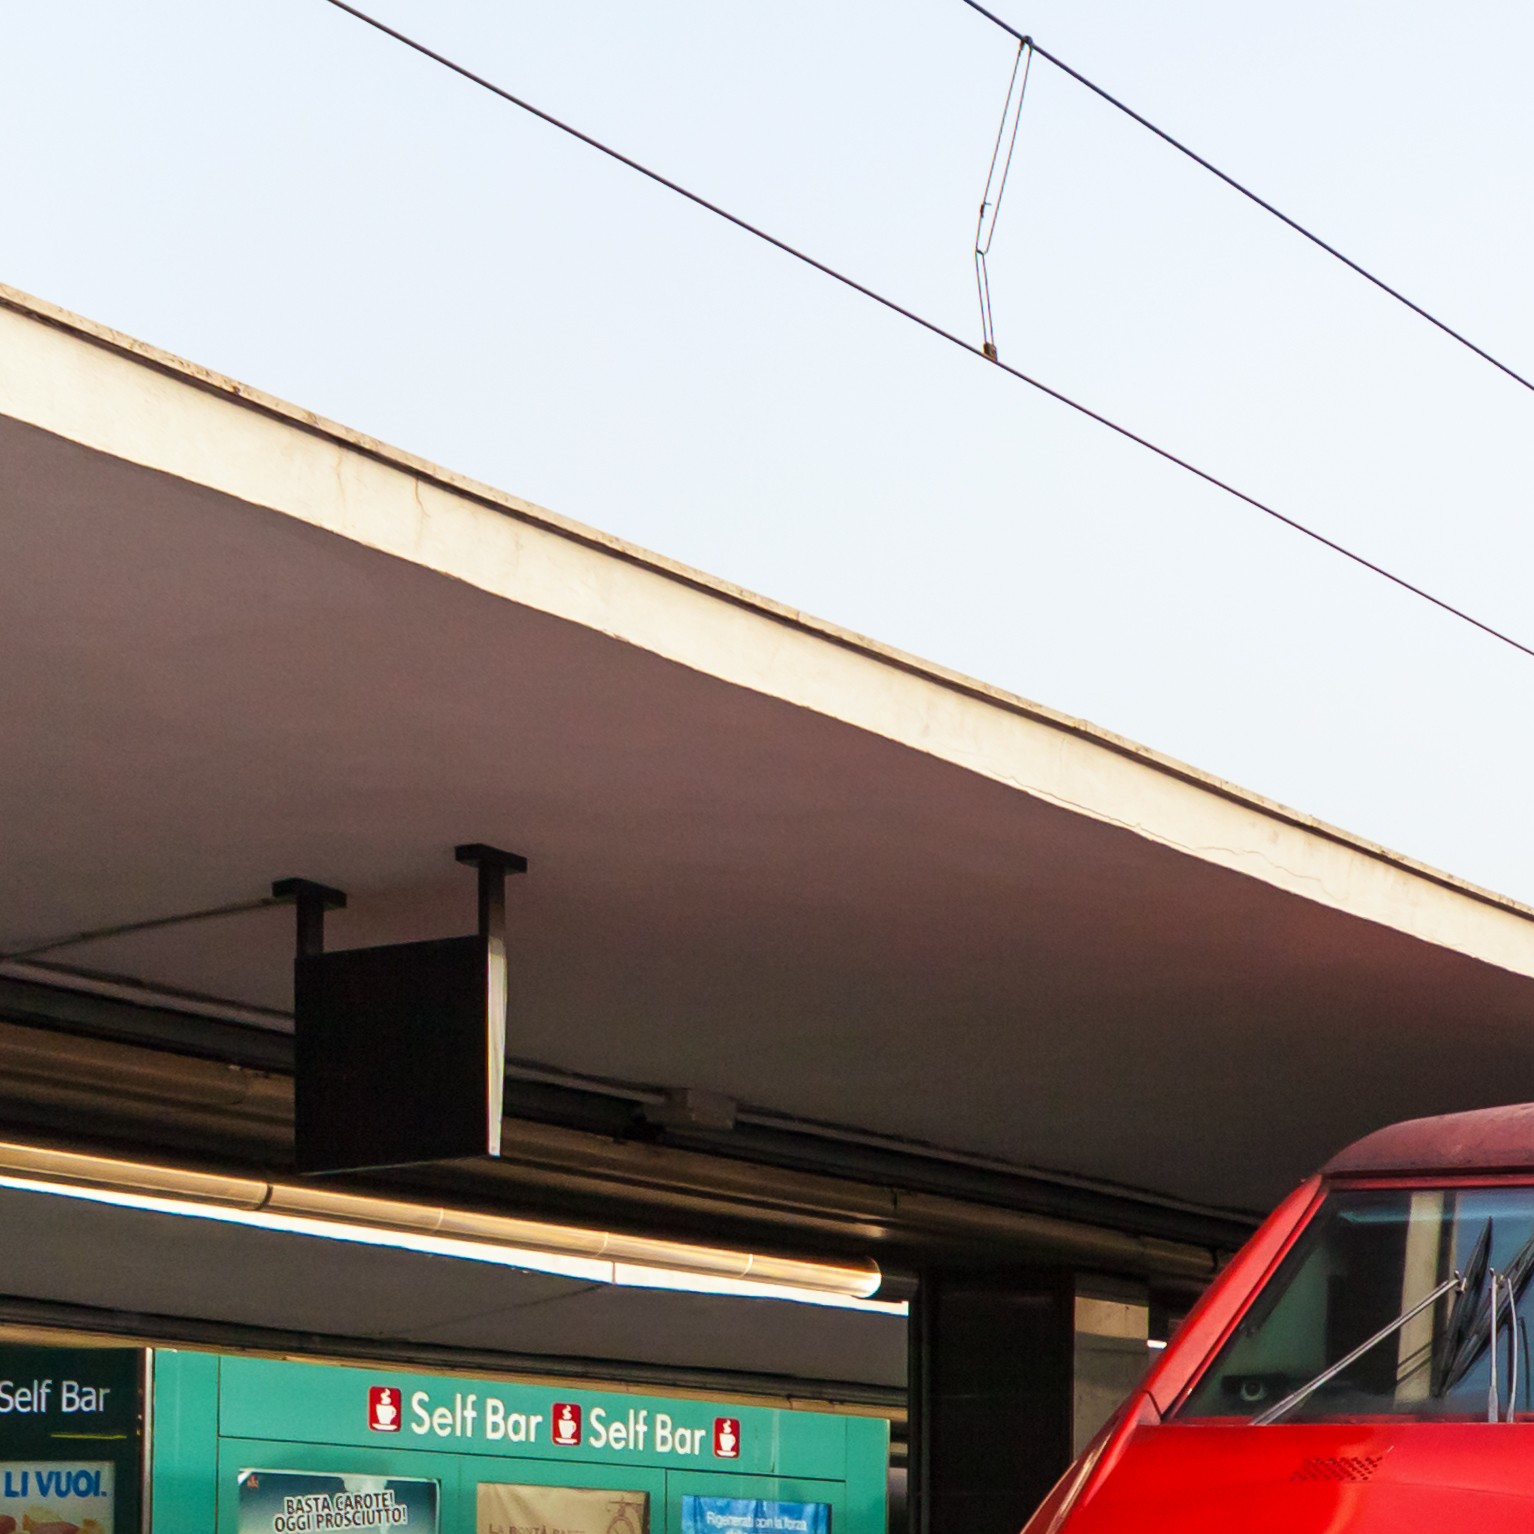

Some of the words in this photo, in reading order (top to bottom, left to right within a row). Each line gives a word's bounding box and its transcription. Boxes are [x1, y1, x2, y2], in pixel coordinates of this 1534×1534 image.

[0, 1380, 53, 1413] Self
[62, 1380, 111, 1412] Bar
[411, 1391, 477, 1438] Self
[485, 1397, 543, 1442] Bar
[589, 1407, 648, 1451] Self
[655, 1414, 706, 1455] Bar
[4, 1471, 29, 1497] LI
[35, 1469, 107, 1498] VUOI.
[285, 1495, 333, 1516] BASTA
[335, 1491, 394, 1511] CAROTE!
[274, 1514, 311, 1533] OGGI
[315, 1506, 407, 1530] PROSCIUTTO!
